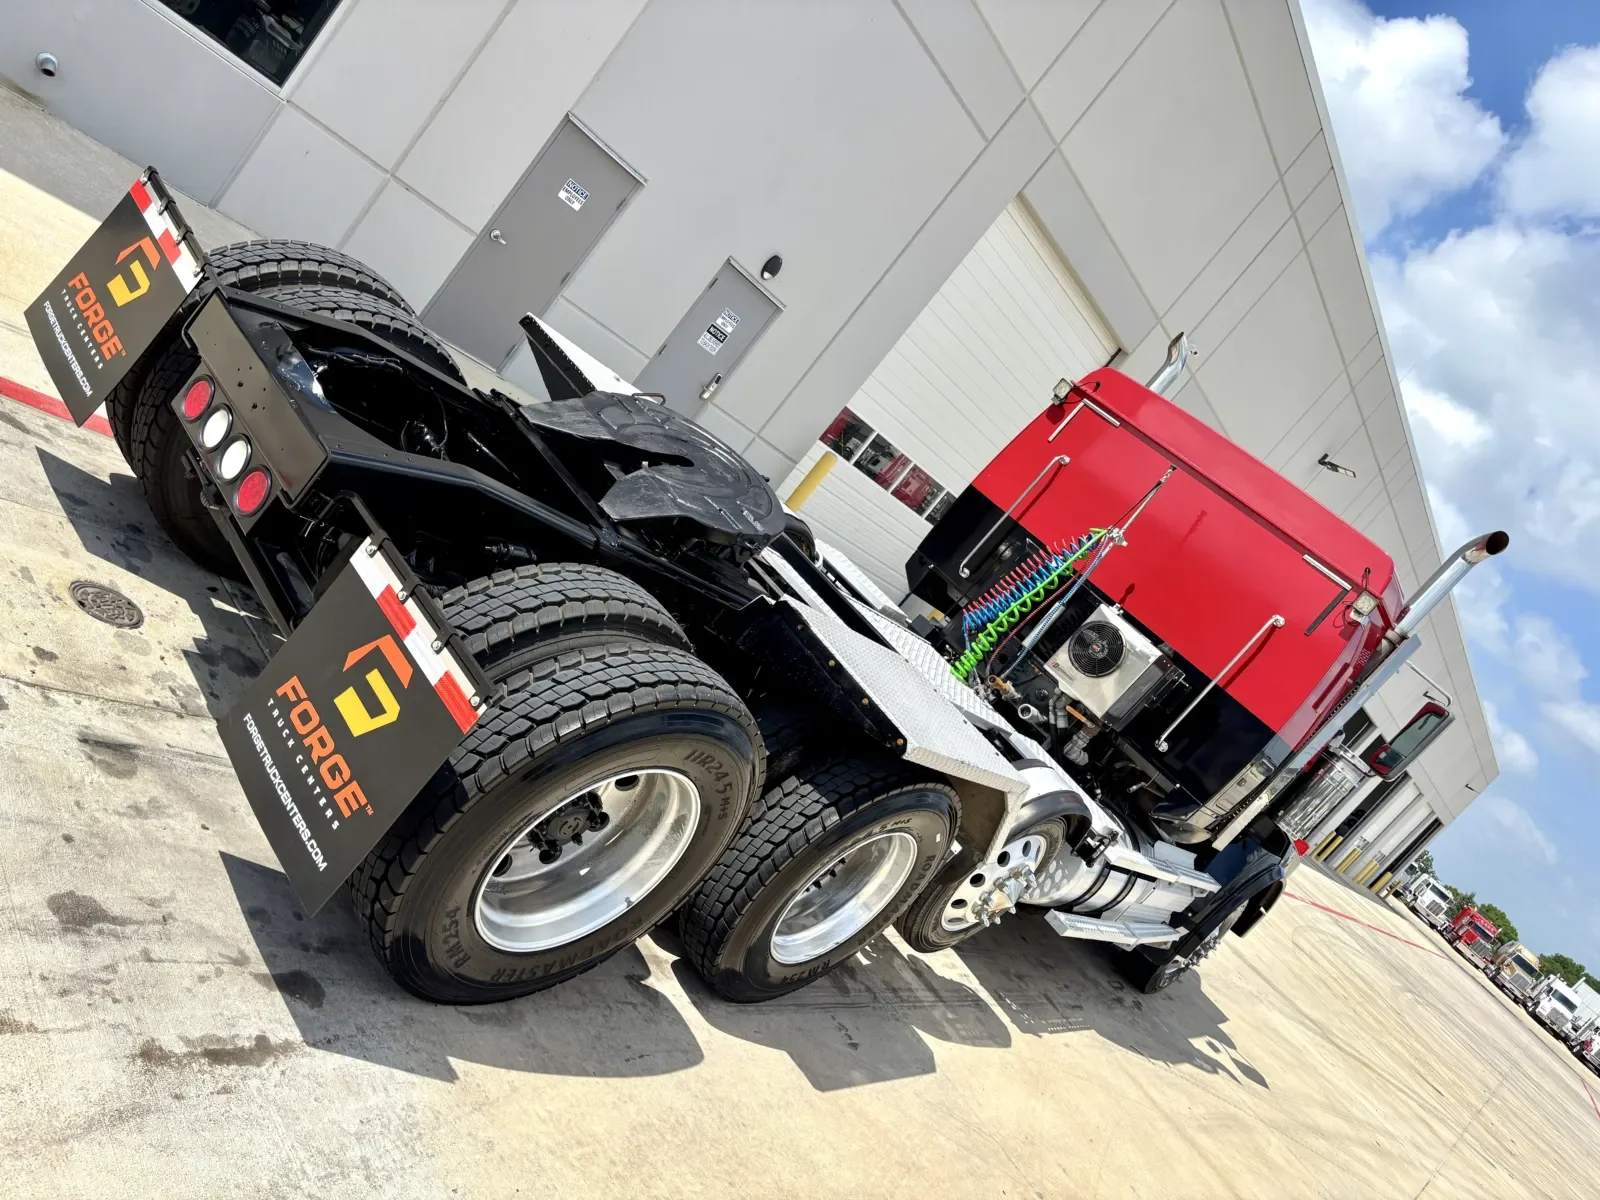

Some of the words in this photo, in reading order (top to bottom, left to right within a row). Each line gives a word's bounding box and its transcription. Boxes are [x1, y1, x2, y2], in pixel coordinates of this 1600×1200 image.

[562, 186, 584, 205] EMPLOYEES
[565, 195, 575, 205] ONLY
[567, 181, 588, 199] NOTICE
[43, 300, 93, 397] FORGETRUCKCENTERS.COM
[61, 289, 78, 321] TRUCK
[77, 324, 103, 370] CENTERS
[68, 271, 123, 360] FORGE
[708, 326, 726, 342] NOTICE
[267, 698, 295, 749] TRUCK
[295, 755, 339, 830] CENTERS
[275, 675, 368, 819] FORGE
[242, 712, 328, 873] FORGETRUCKCENTERS.COM
